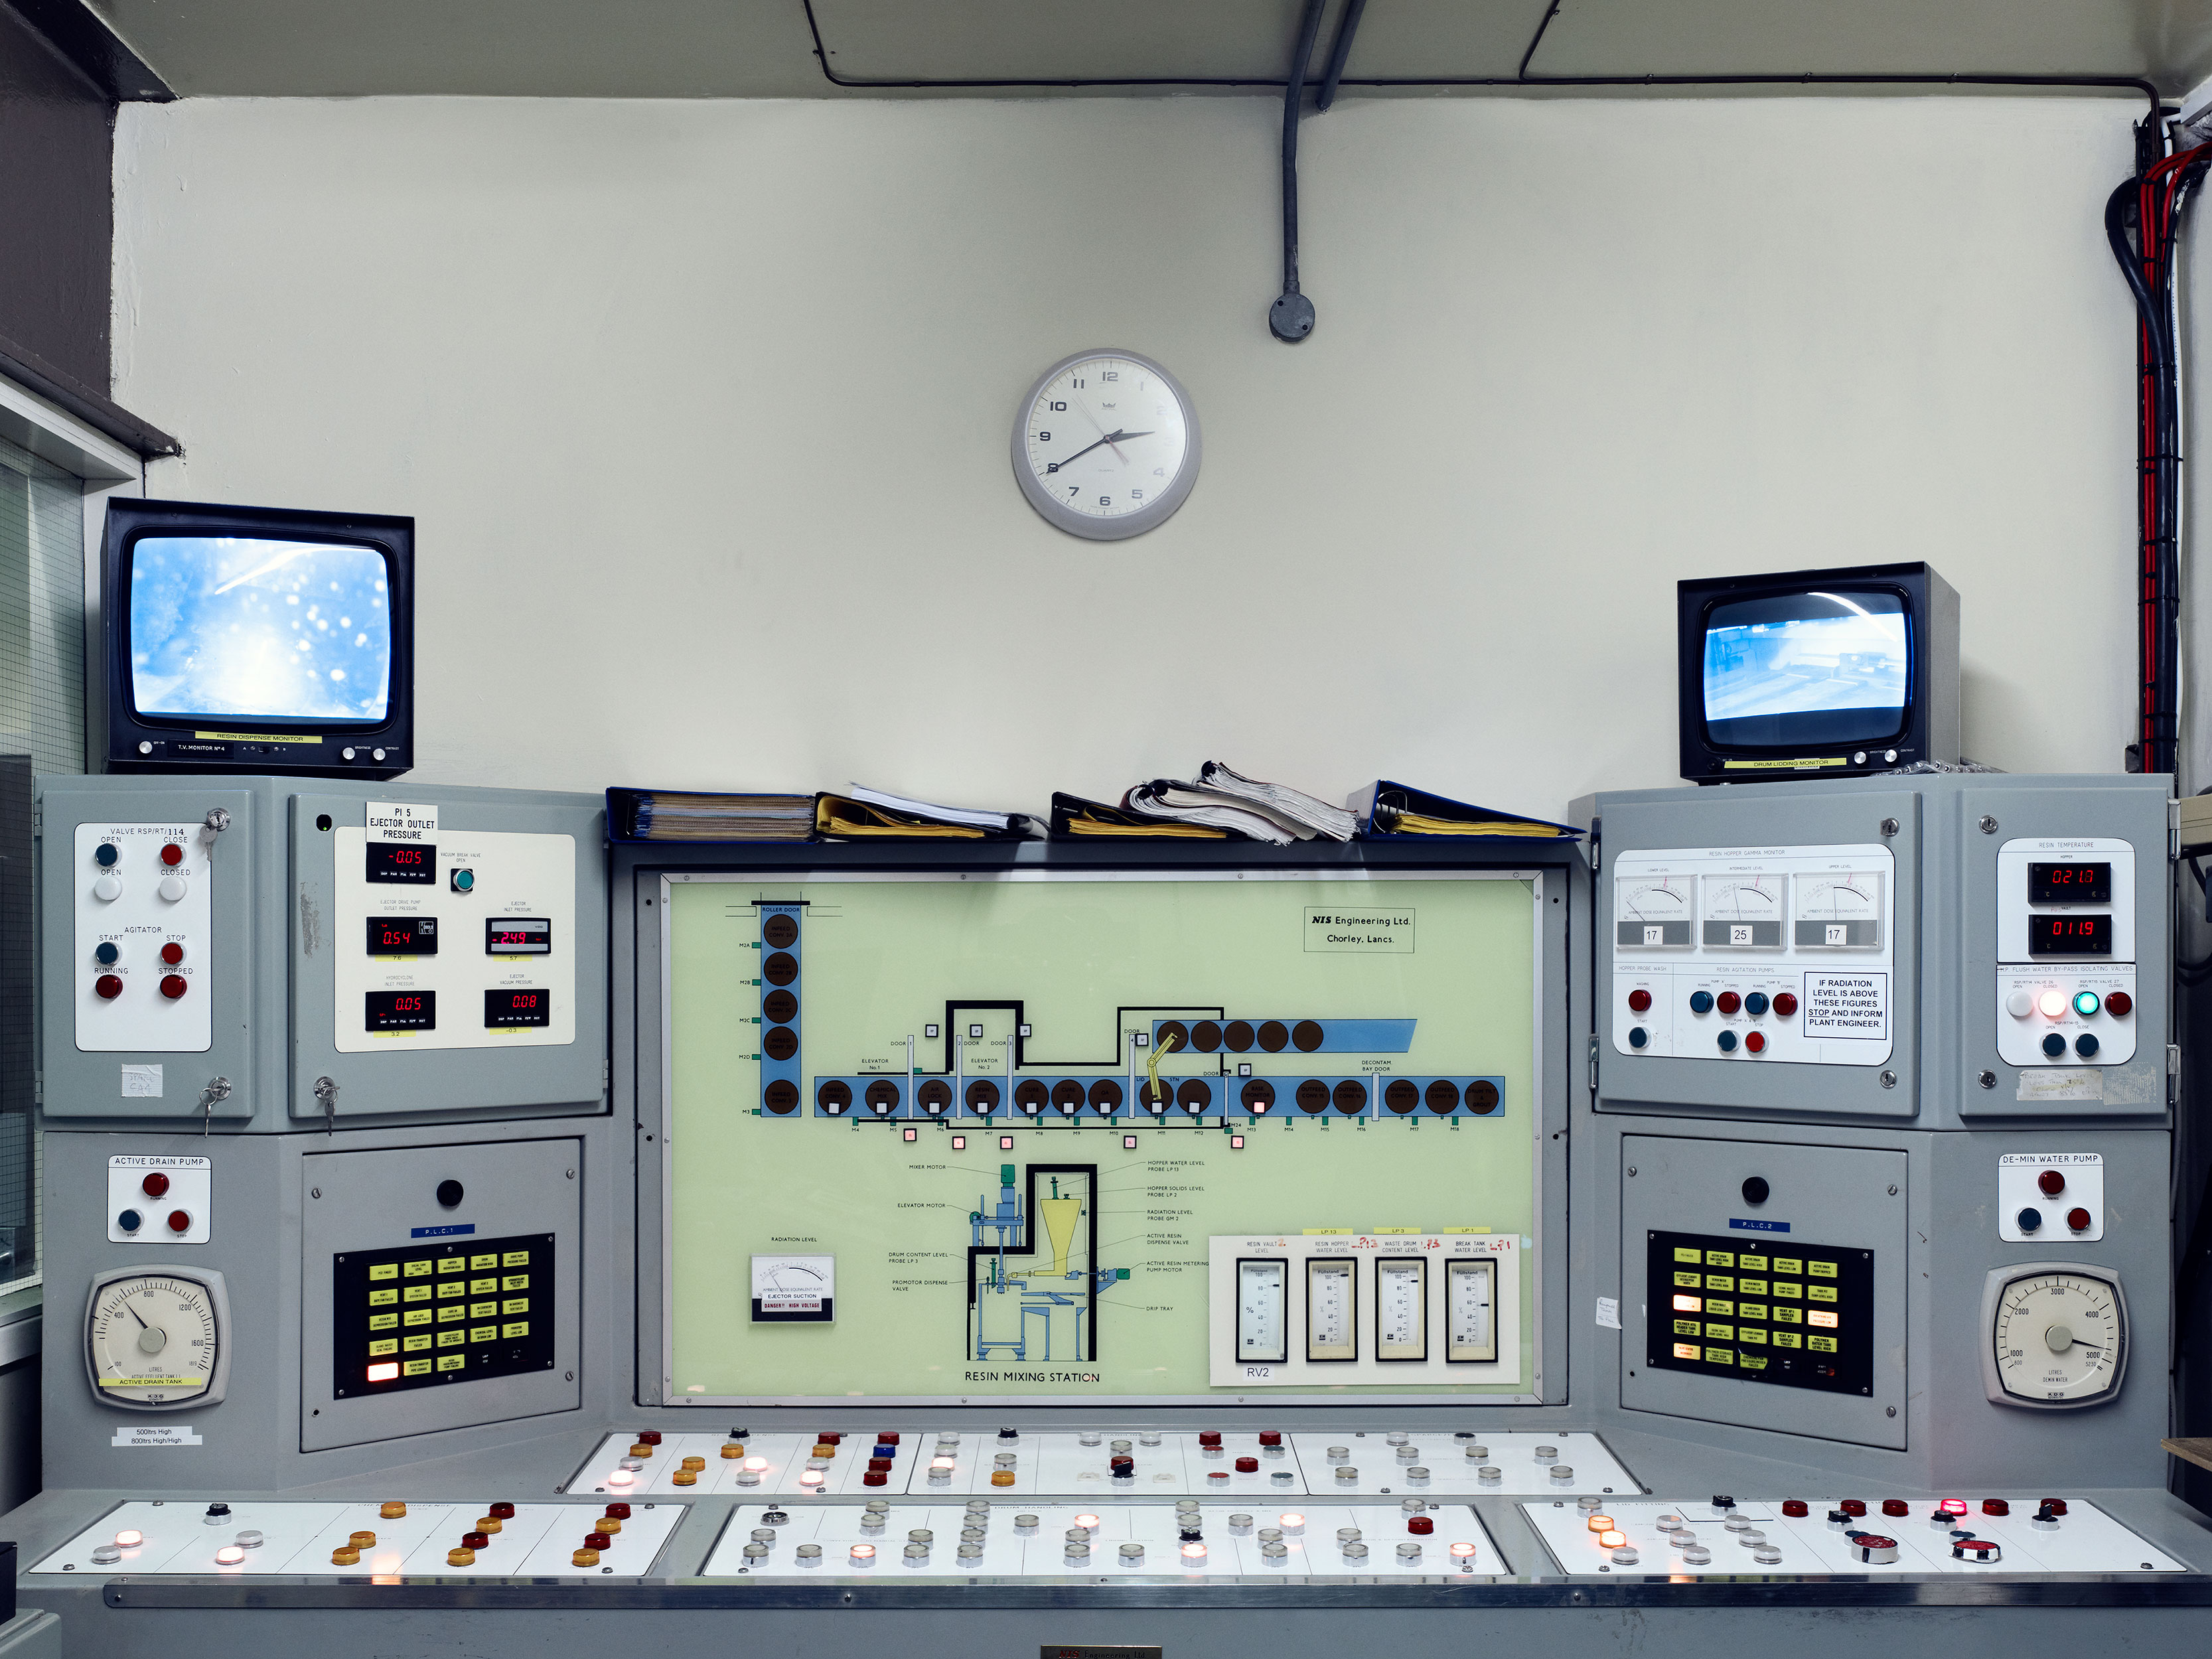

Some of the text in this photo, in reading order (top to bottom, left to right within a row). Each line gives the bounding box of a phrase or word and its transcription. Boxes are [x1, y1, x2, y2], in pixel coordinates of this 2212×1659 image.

[1102, 372, 1118, 382] 12
[1073, 378, 1084, 389] 11
[1050, 401, 1067, 411] 10
[1039, 431, 1051, 441] 9
[1069, 486, 1080, 497] 7
[1132, 489, 1143, 499] 5
[1099, 496, 1111, 506] 6
[406, 808, 411, 817] 5
[370, 818, 435, 829] EJECTOR OUTLET
[383, 830, 421, 839] PRESSURE
[1335, 916, 1390, 926] Engineering
[1393, 917, 1411, 926] Ltd.
[1367, 935, 1394, 944] Lancs.
[1646, 930, 1657, 940] 17
[1733, 930, 1747, 940] 25
[1828, 930, 1840, 939] 17
[1831, 1009, 1848, 1018] AND
[1850, 1009, 1883, 1018] INFORM
[1808, 1019, 1881, 1028] PLANT ENGINEER.
[965, 1371, 1100, 1383] RESIN MIXING STATION
[1247, 1367, 1269, 1378] RV2
